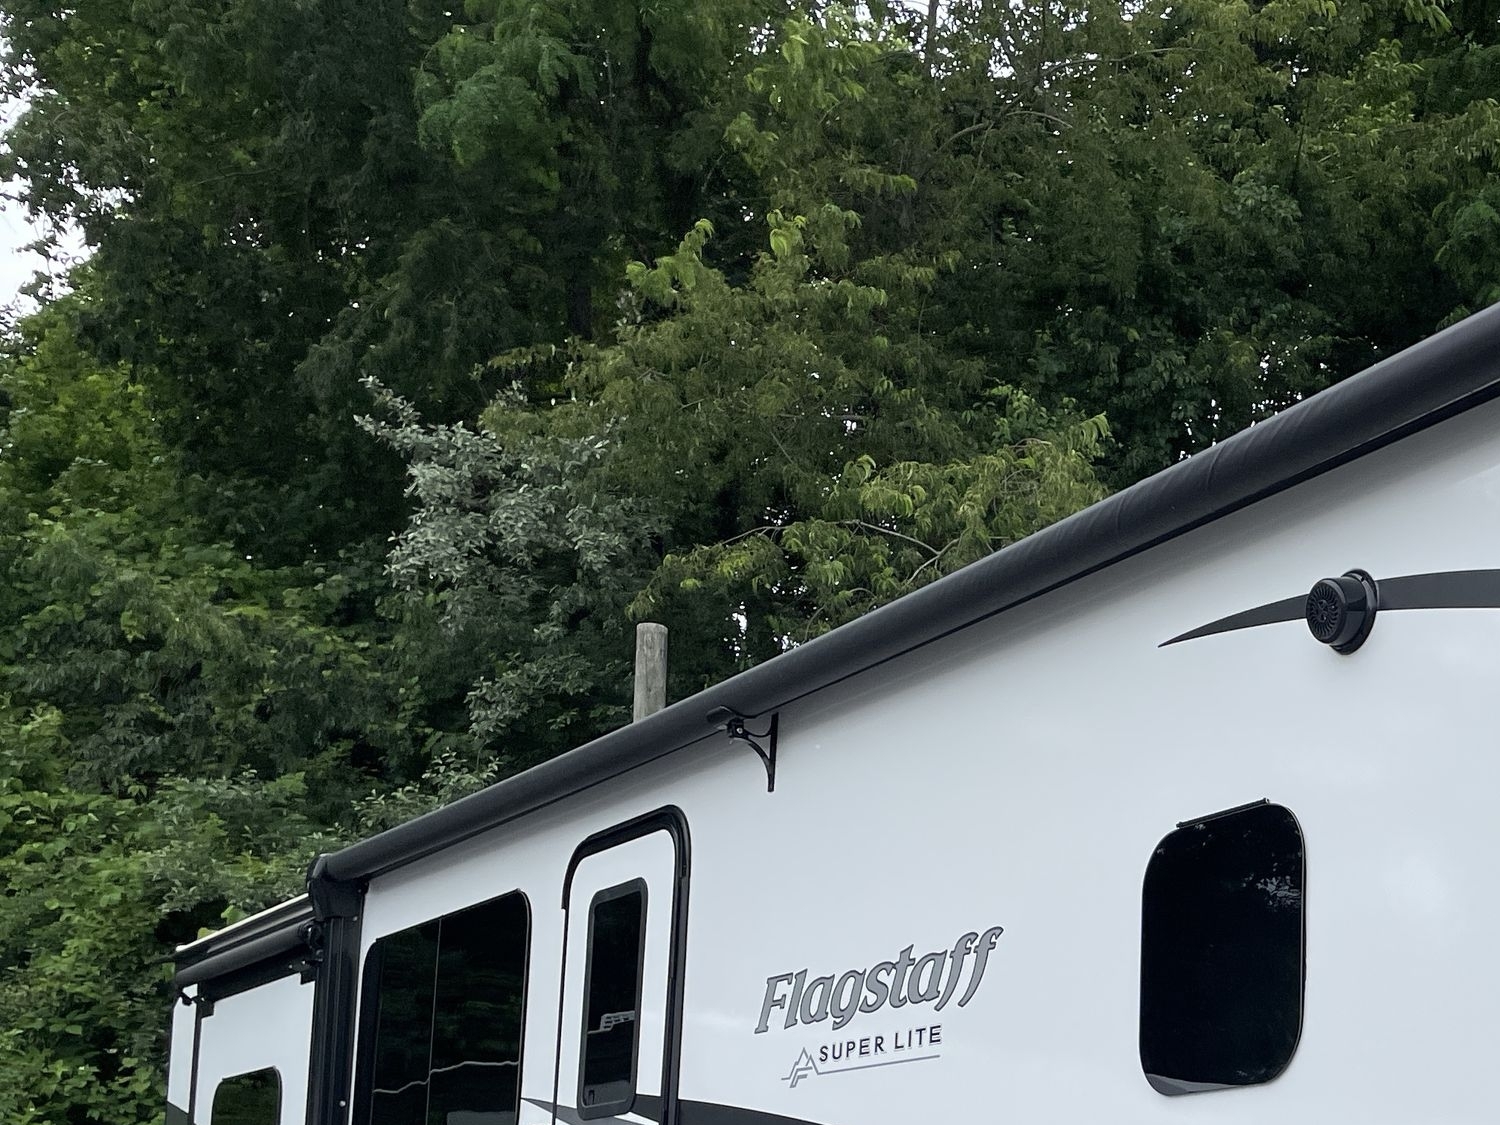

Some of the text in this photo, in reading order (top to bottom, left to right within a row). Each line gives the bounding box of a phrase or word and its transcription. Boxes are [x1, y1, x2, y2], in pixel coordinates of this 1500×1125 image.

[754, 926, 1004, 1034] Flagstaff
[819, 1025, 942, 1062] SUPER LITE
